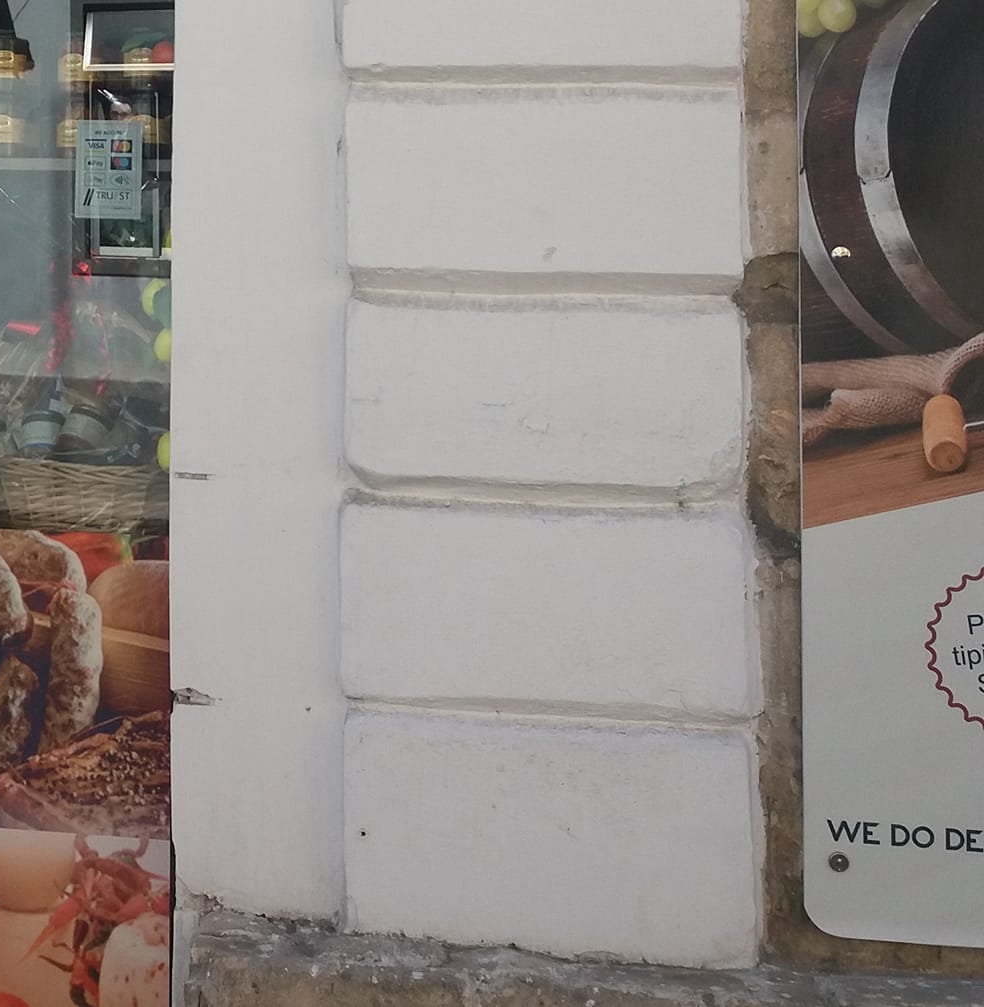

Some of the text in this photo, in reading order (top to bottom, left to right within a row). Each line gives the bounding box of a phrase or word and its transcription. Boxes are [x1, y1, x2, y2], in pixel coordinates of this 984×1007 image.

[826, 819, 984, 854] WE DO DE
